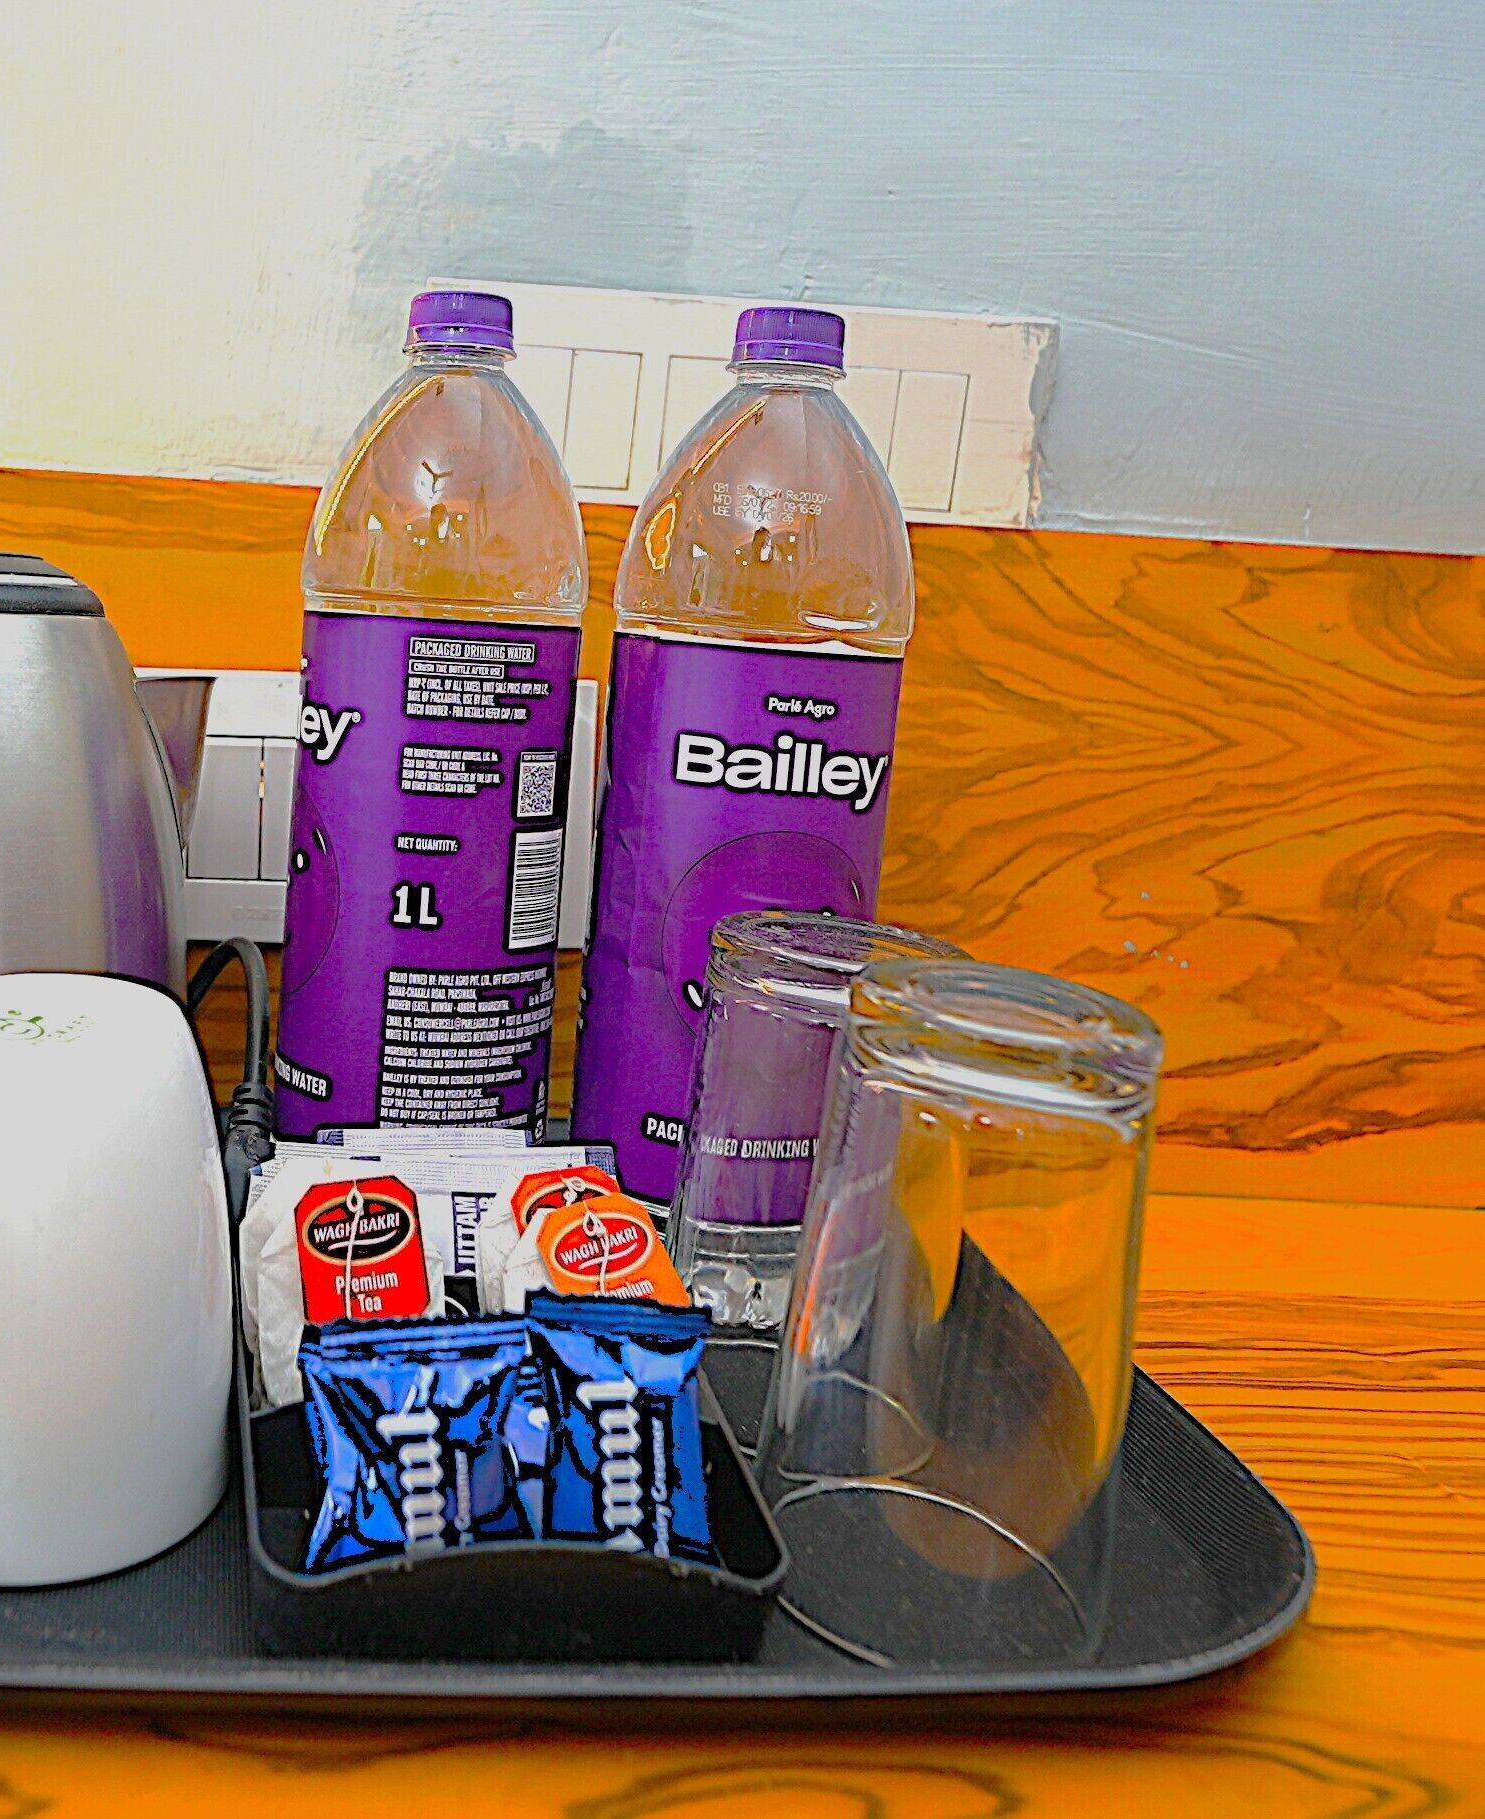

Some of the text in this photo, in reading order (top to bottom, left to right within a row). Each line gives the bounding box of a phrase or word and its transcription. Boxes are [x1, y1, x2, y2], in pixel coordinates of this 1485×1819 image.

[414, 641, 531, 660] PACKAGED DRINKING WATER
[449, 665, 470, 674] BOTTLE
[472, 667, 489, 675] AFTER
[490, 668, 500, 676] USE
[804, 700, 834, 718] Agro
[676, 734, 886, 810] Bailley
[398, 837, 457, 852] NET QUANTITY:
[292, 1068, 326, 1096] WATER
[741, 1139, 809, 1159] DRINKING
[360, 1212, 400, 1234] BAKRI
[560, 1243, 599, 1265] WAGH
[335, 1271, 399, 1295] Pemium
[357, 1293, 382, 1313] Tea
